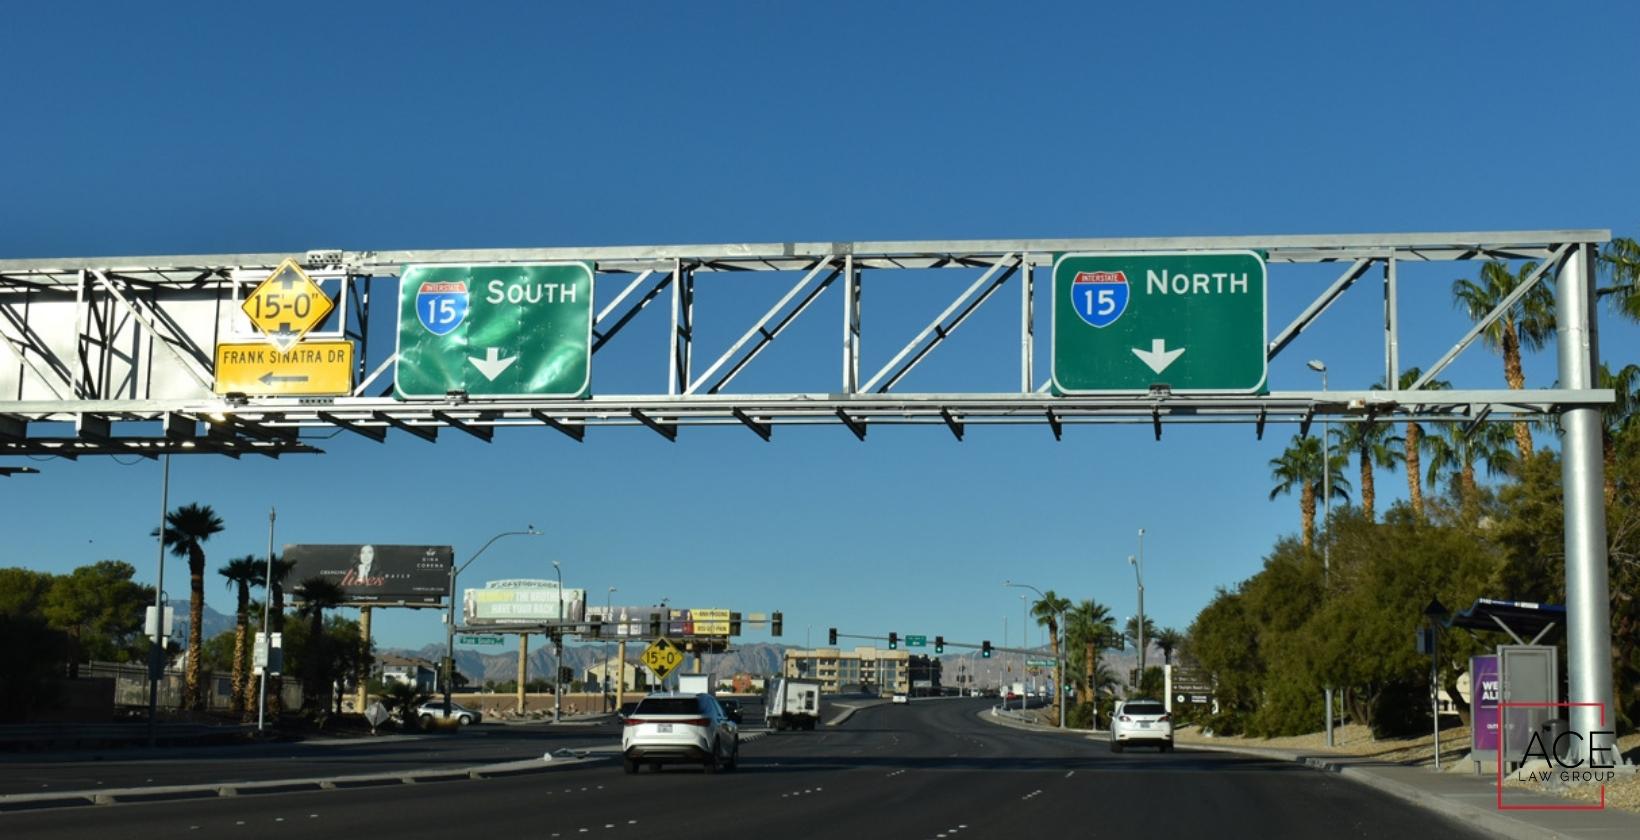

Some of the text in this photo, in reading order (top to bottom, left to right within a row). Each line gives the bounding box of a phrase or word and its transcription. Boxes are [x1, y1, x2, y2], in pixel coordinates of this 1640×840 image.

[1081, 274, 1118, 282] INTERSTATE
[1146, 269, 1248, 295] NORTH
[486, 279, 577, 304] SOUTH
[1084, 289, 1116, 316] 15
[428, 299, 456, 324] 15
[223, 349, 345, 364] FRANK SINATRA DR
